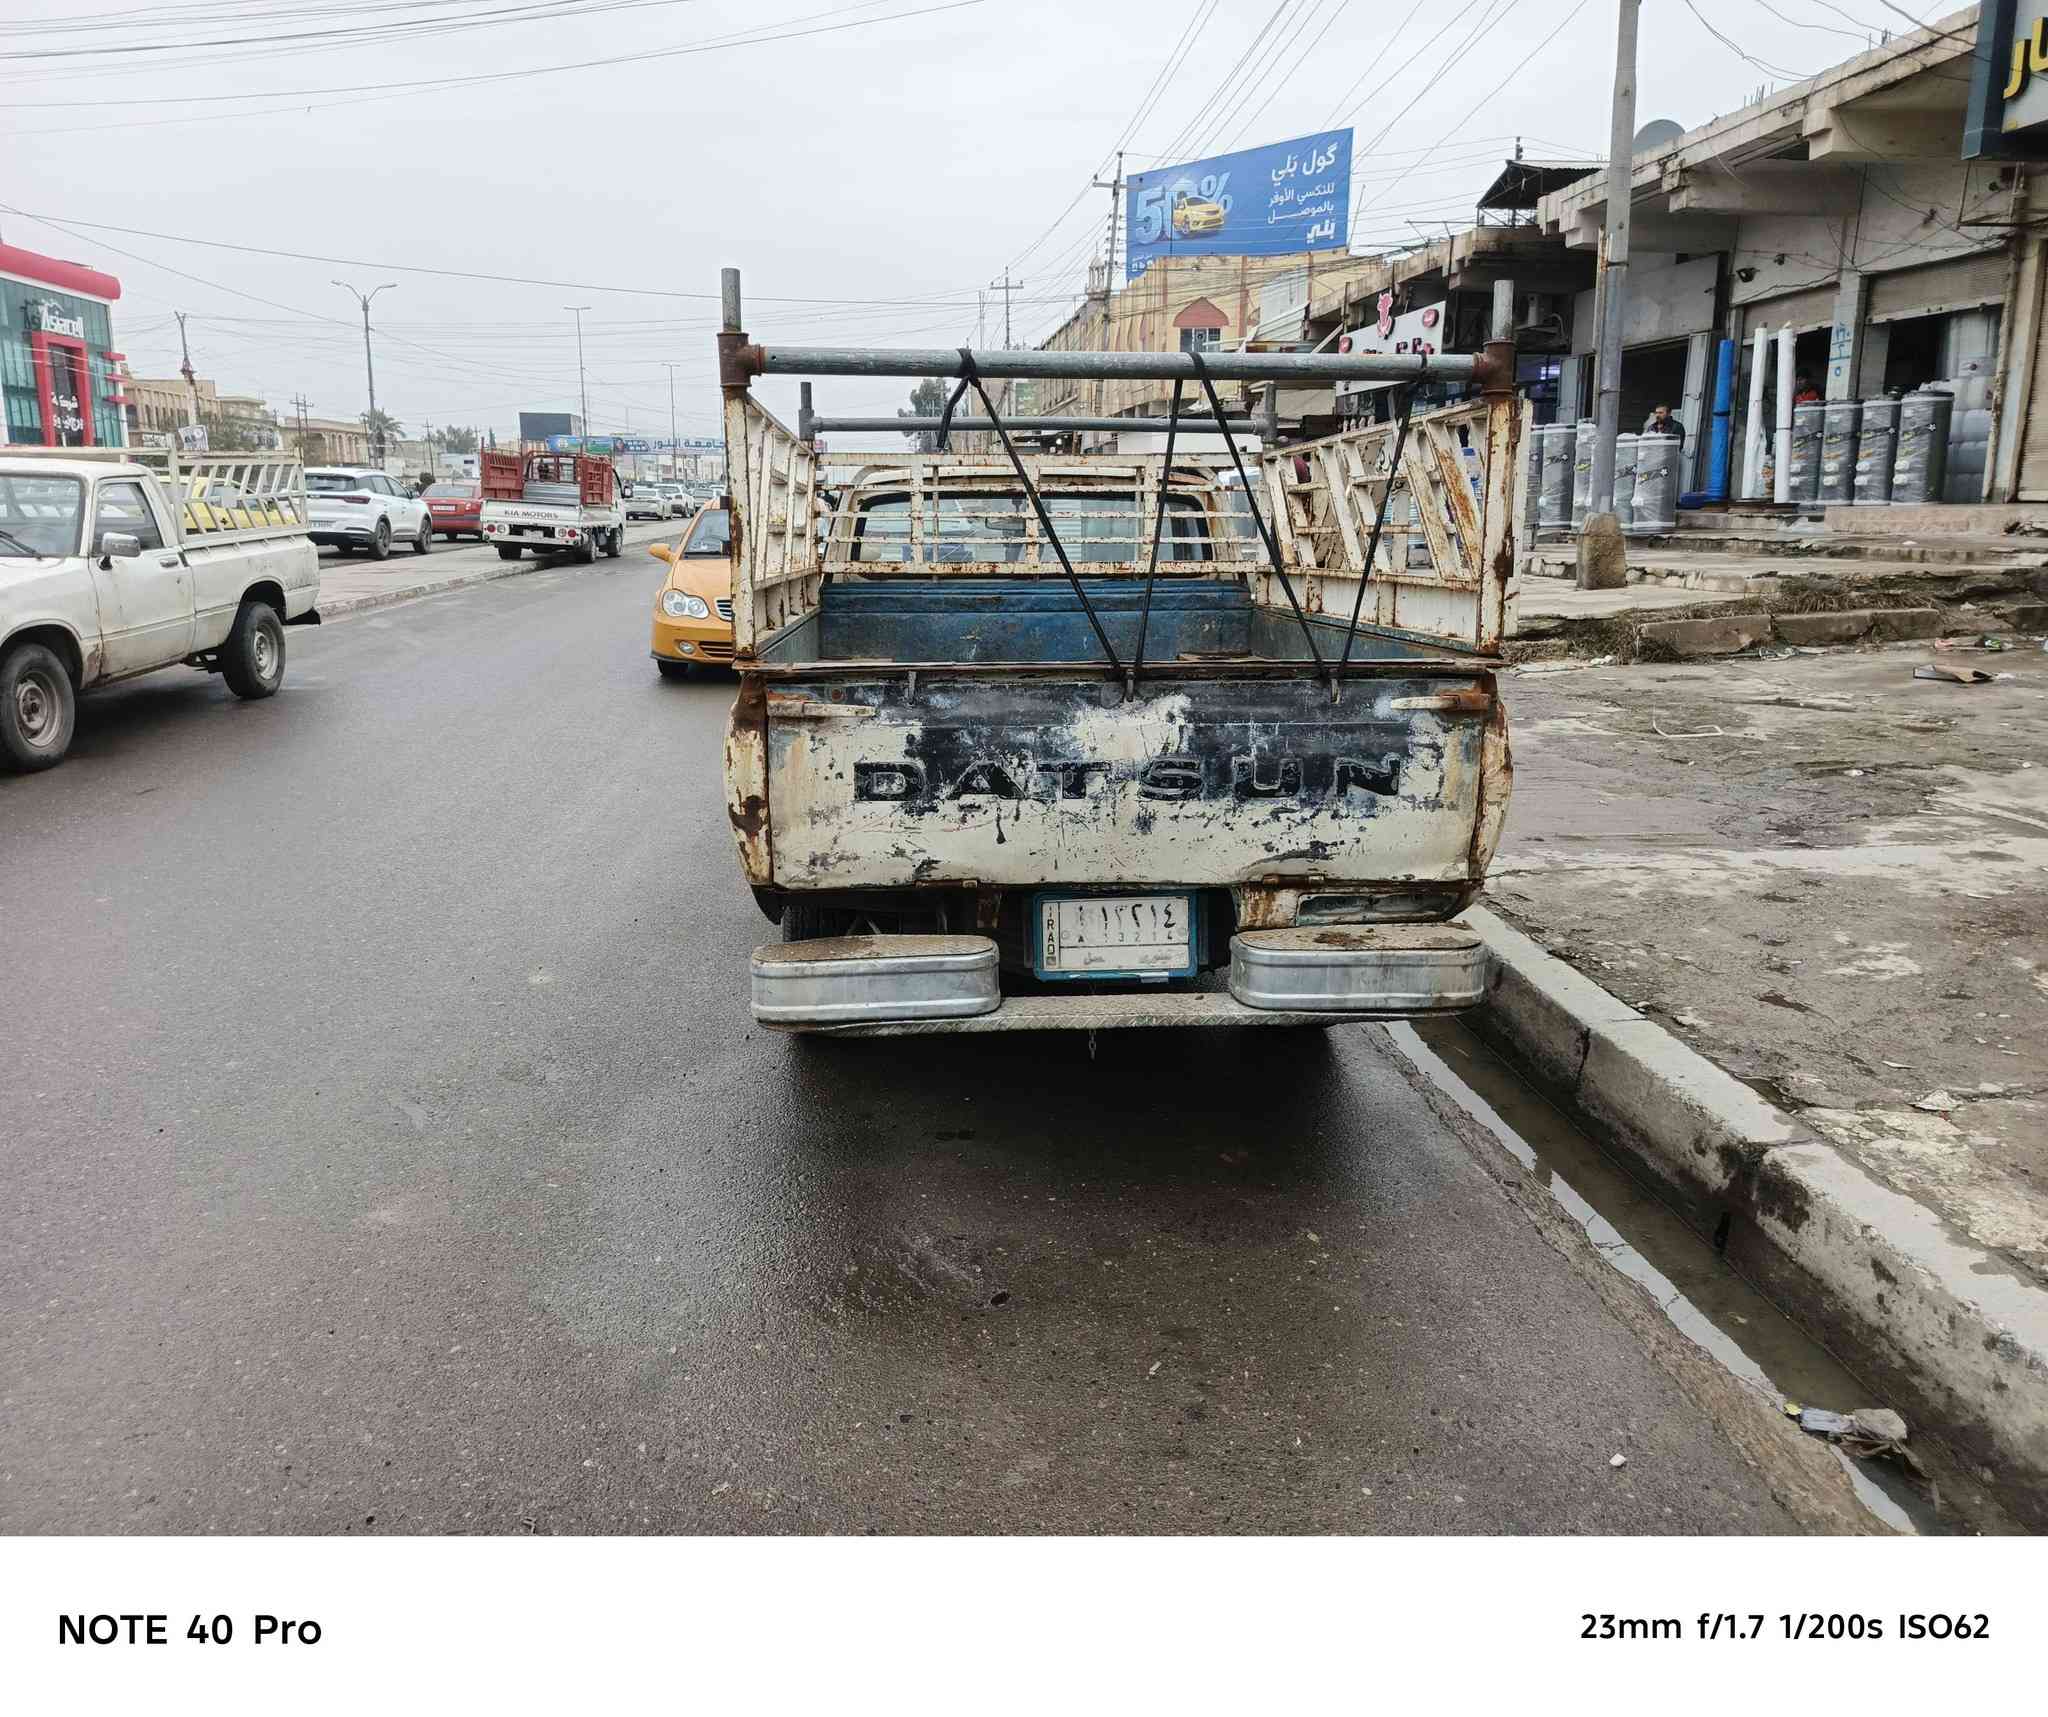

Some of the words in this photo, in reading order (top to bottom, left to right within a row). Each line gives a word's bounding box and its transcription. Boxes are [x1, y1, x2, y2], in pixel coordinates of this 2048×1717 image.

[1302, 142, 1338, 175] گول
[521, 510, 559, 519] MOTORS
[853, 754, 1402, 801] DATSUN
